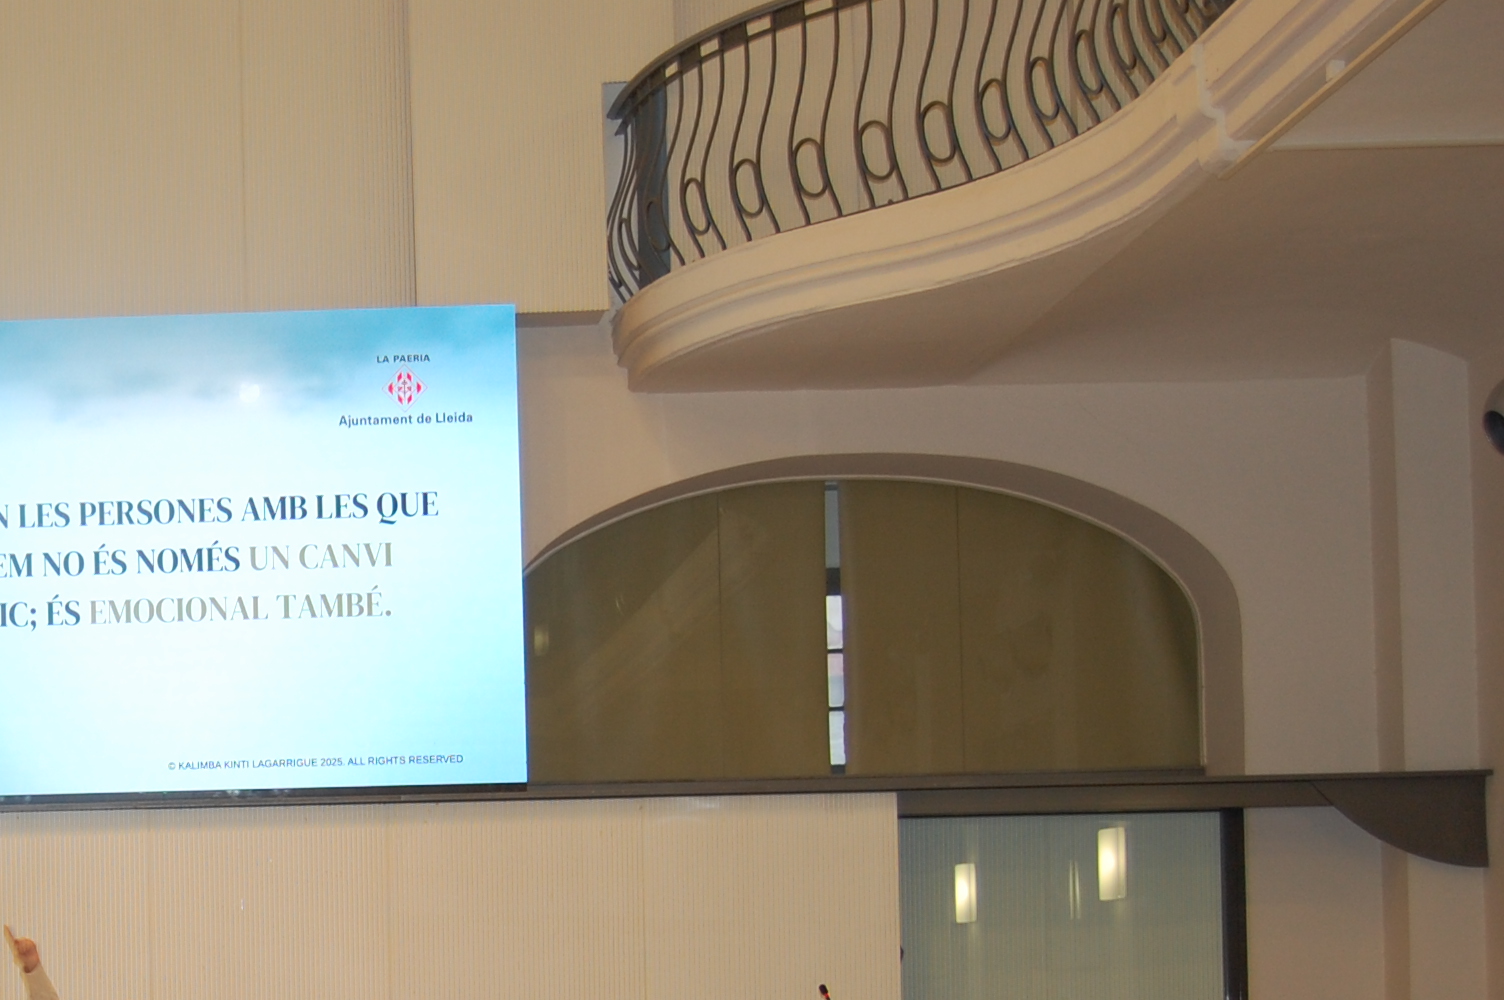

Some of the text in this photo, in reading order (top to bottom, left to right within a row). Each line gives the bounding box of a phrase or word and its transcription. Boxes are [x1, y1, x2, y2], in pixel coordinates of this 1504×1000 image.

[376, 354, 430, 364] LA PAERIA
[339, 411, 473, 429] Ajuntament de Lleida
[18, 502, 71, 529] LES
[78, 497, 233, 527] PERSONES
[240, 495, 309, 522] AMB
[315, 493, 369, 520] LES
[376, 491, 440, 525] QUE
[42, 551, 86, 578] NO
[92, 543, 128, 576] ÉS
[135, 540, 241, 575] NOMÉS
[248, 545, 290, 571] UN
[298, 542, 393, 570] CANVI
[46, 594, 82, 627] ÉS
[90, 595, 269, 626] EMOCIONAL
[275, 585, 392, 620] TAMBÉ.
[178, 760, 222, 770] KALIMBA
[224, 760, 249, 769] KINTI
[252, 758, 318, 769] LAGARRIGUE
[320, 757, 345, 767] 2025.
[347, 757, 365, 766] ALL
[368, 755, 406, 766] RIGHTS
[408, 754, 464, 765] RESERVED
